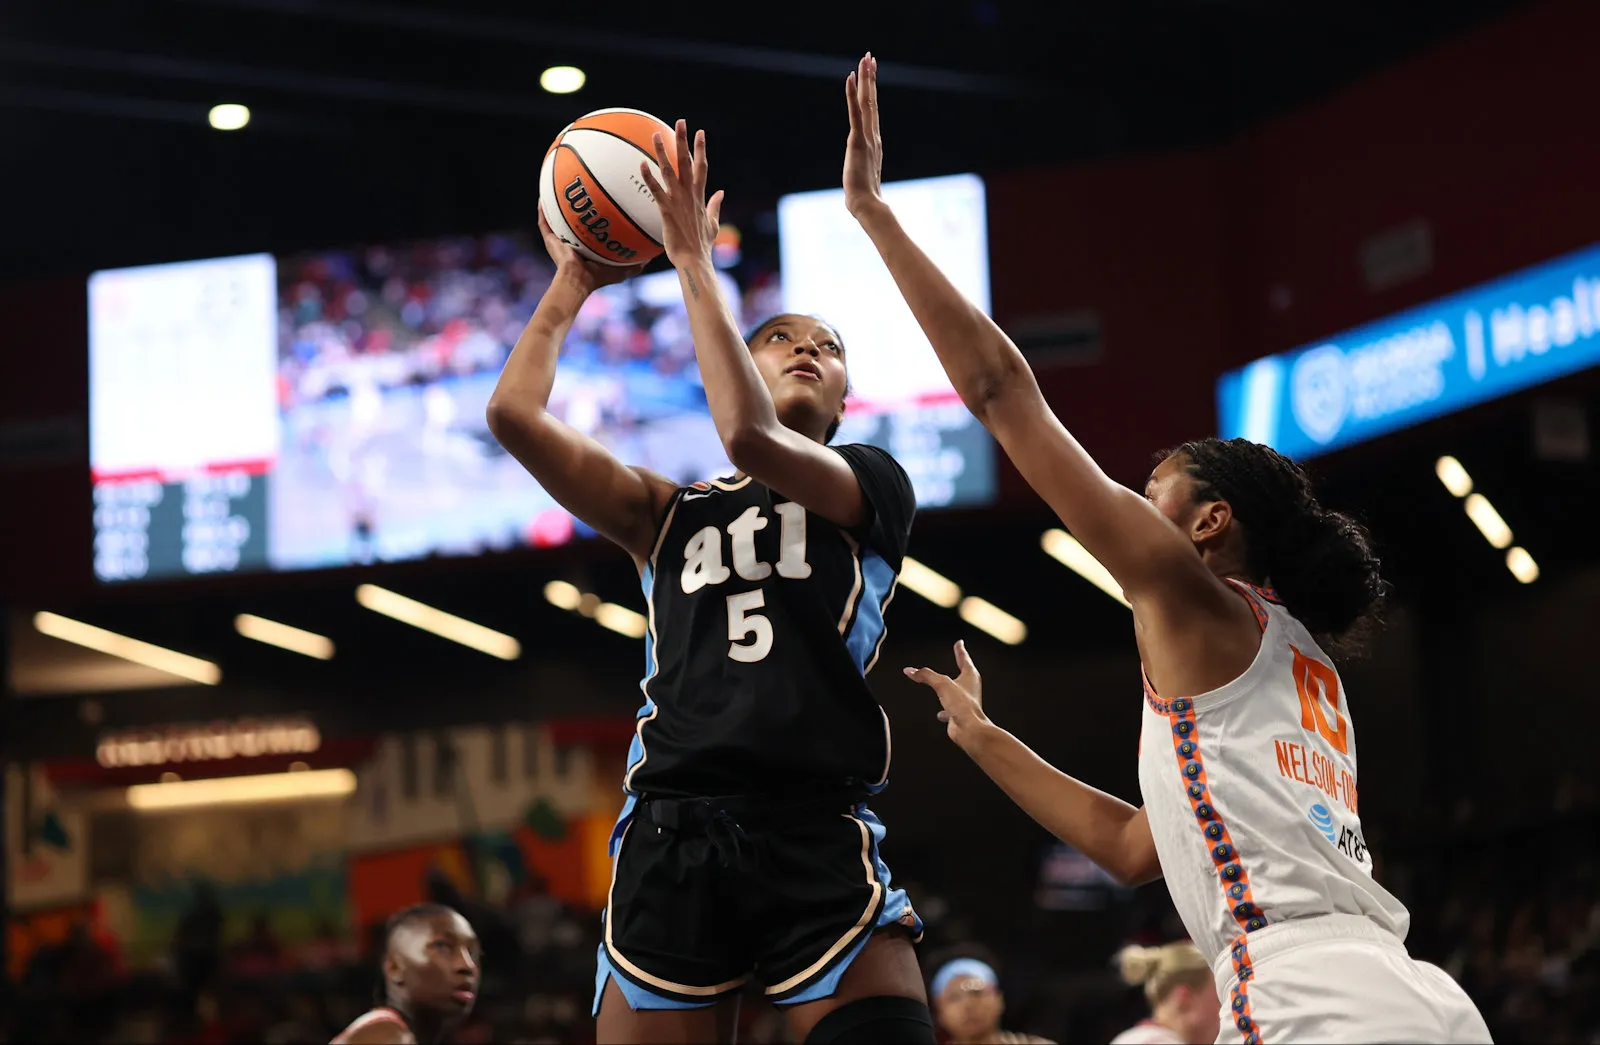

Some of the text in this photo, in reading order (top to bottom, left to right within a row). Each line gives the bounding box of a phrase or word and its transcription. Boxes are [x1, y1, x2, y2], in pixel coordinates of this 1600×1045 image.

[564, 176, 638, 259] Wilson
[680, 501, 812, 595] atl
[726, 588, 774, 663] 5
[1288, 642, 1347, 755] 10
